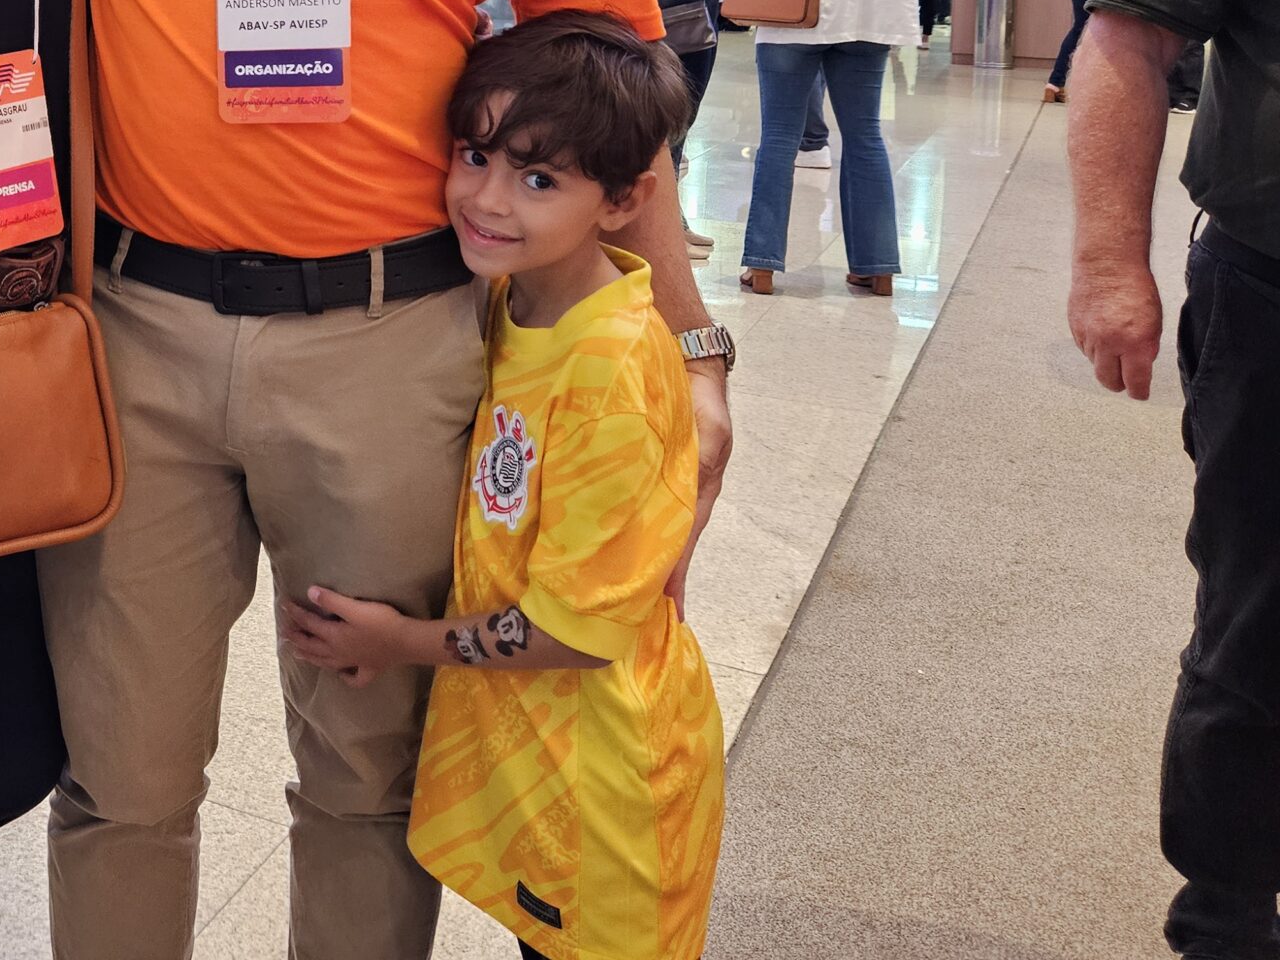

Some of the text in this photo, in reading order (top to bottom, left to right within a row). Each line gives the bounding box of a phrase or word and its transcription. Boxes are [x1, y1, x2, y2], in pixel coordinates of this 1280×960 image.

[239, 18, 328, 31] ABAV-SP AVIESP
[234, 60, 333, 76] ORGANIZAÇÃO
